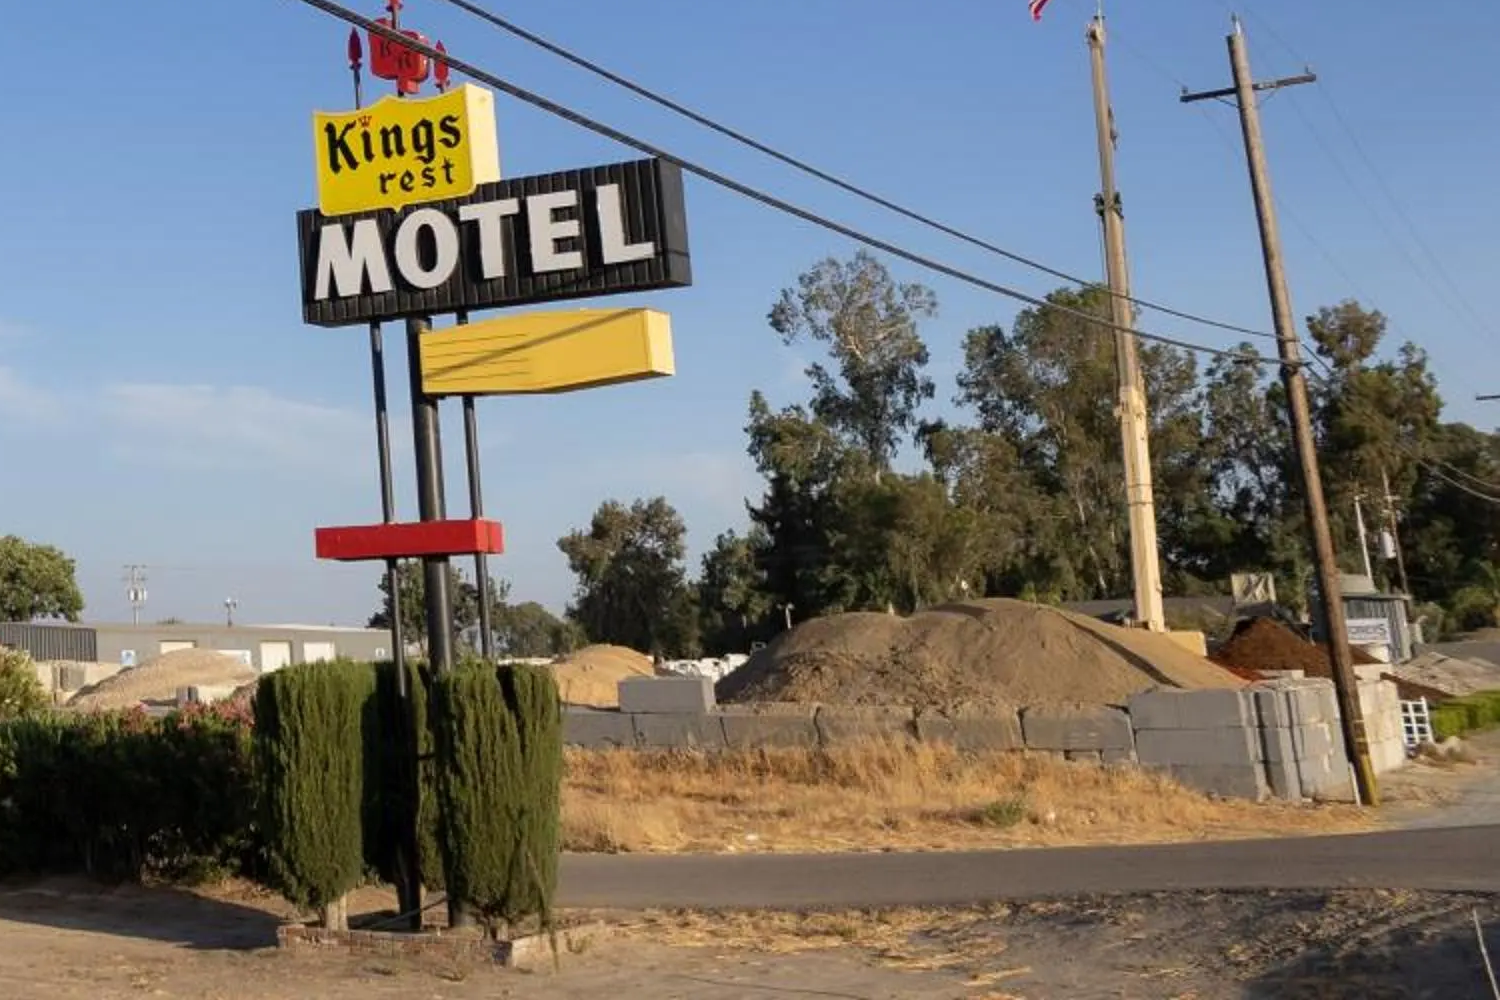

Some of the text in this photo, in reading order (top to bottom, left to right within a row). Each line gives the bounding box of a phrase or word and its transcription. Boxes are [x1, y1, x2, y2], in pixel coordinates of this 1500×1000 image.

[324, 114, 461, 174] Kings
[379, 157, 454, 194] rest
[314, 183, 654, 300] MOTEL
